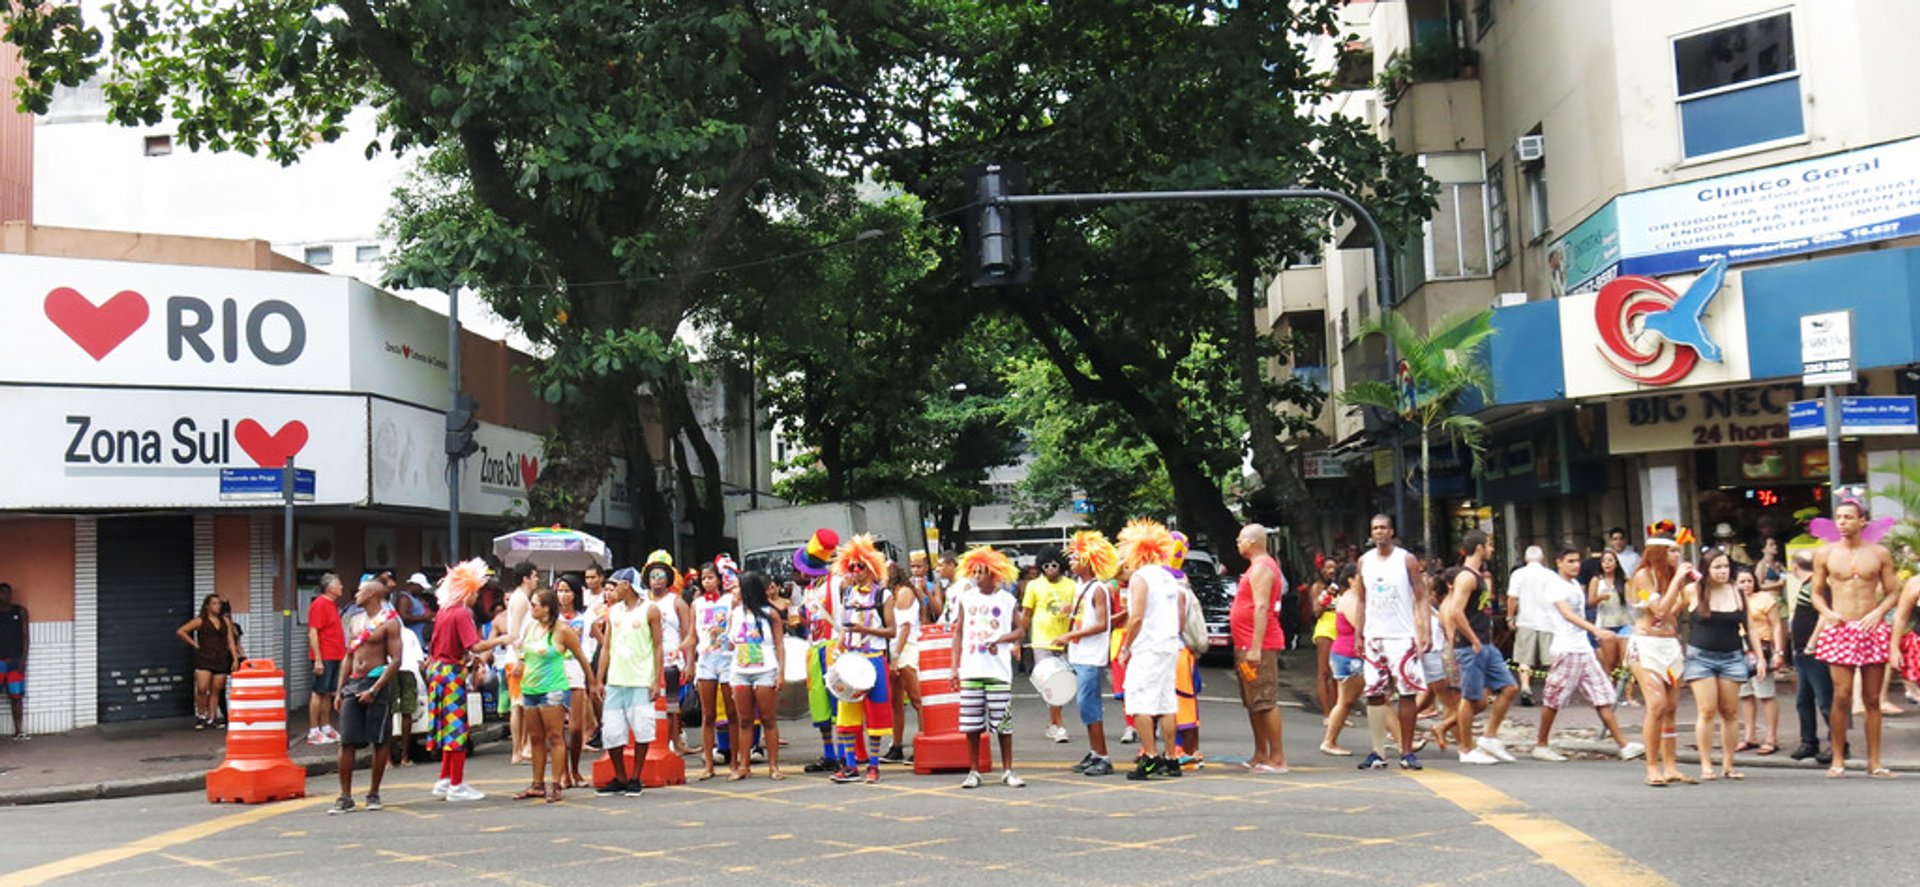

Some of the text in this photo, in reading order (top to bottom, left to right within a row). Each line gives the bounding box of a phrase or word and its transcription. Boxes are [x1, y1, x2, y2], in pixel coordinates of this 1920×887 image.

[1802, 157, 1880, 182] Geral
[1648, 208, 1757, 232] ORTODONTIA
[1670, 213, 1781, 238] ENDODONTIA
[1655, 231, 1735, 250] CIRURGIA
[167, 296, 307, 366] RIO
[1627, 393, 1687, 426] BIG
[64, 416, 229, 464] Zona Sul
[1692, 424, 1723, 446] 24
[480, 446, 520, 487] Zona Sul
